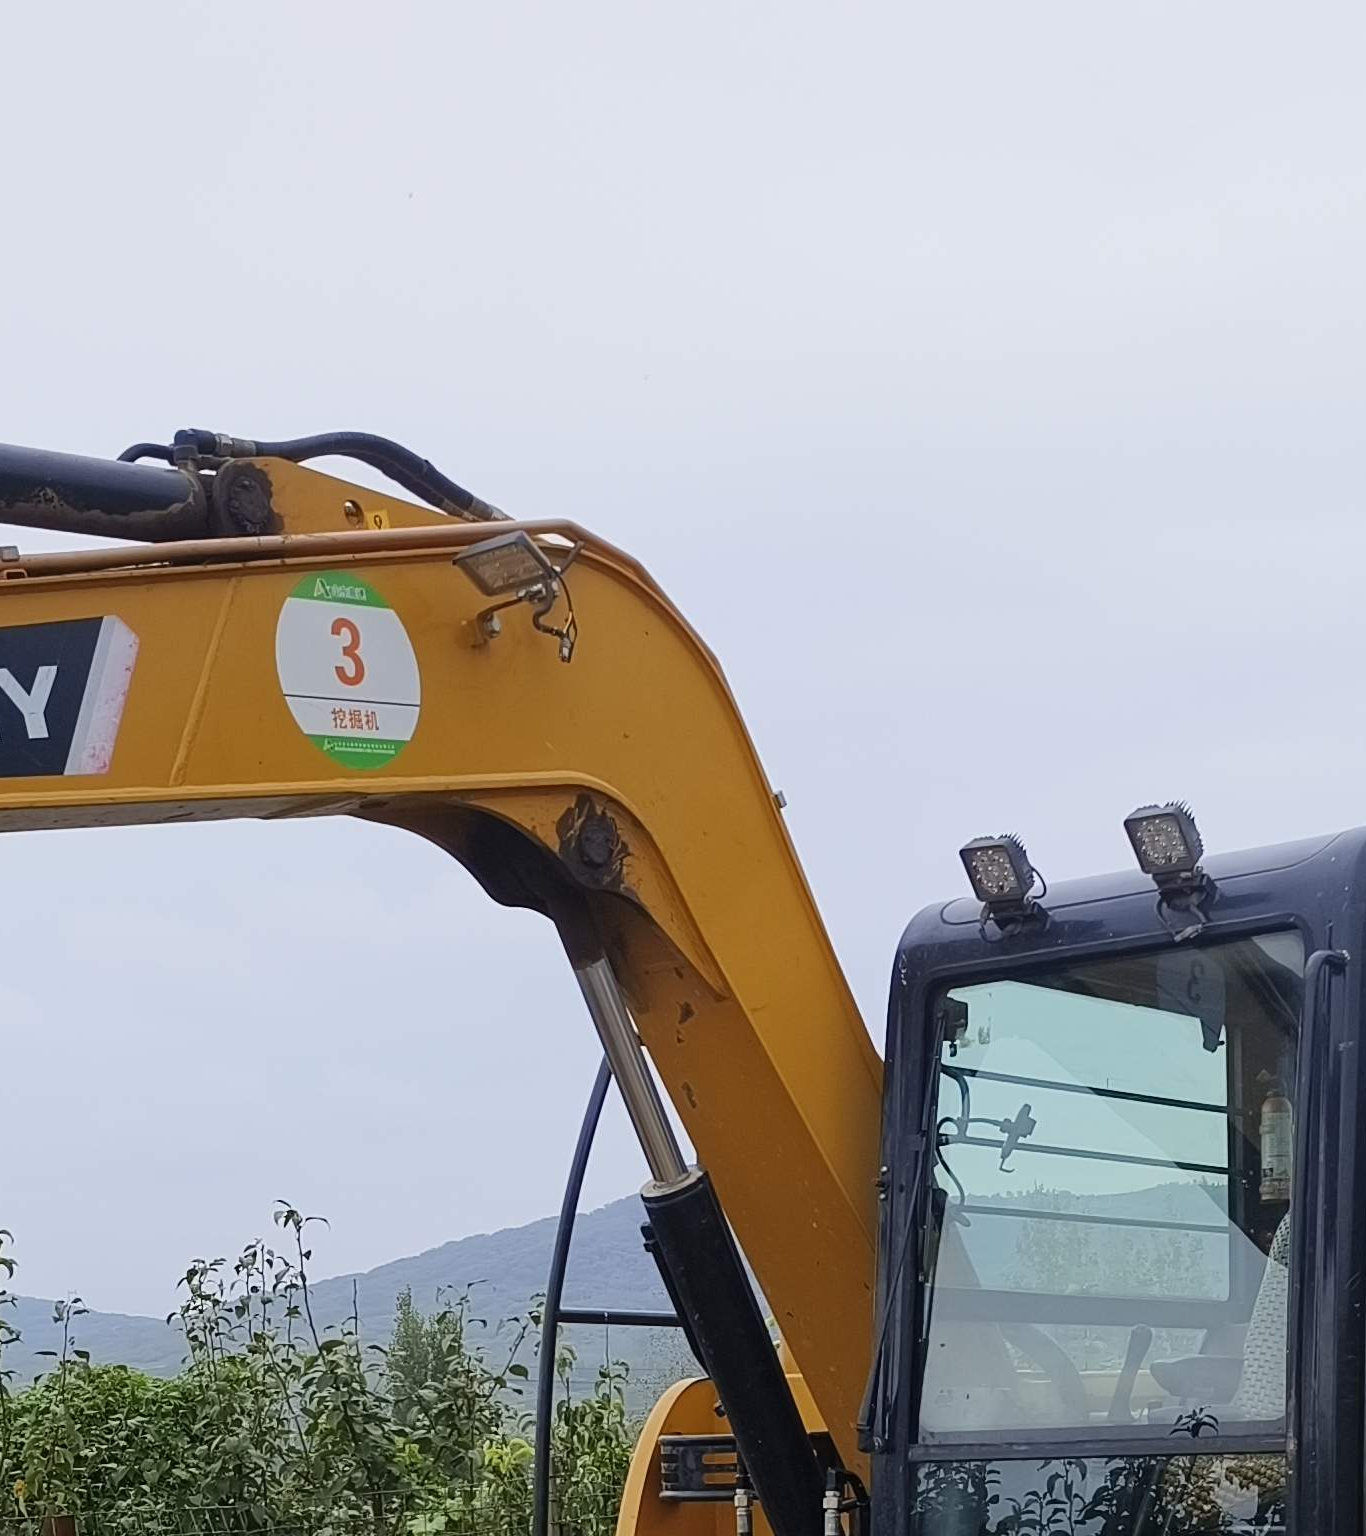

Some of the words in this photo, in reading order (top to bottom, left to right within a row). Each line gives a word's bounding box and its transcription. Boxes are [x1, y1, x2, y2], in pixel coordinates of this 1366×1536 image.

[330, 617, 365, 686] 3
[330, 707, 380, 731] 挖掘机
